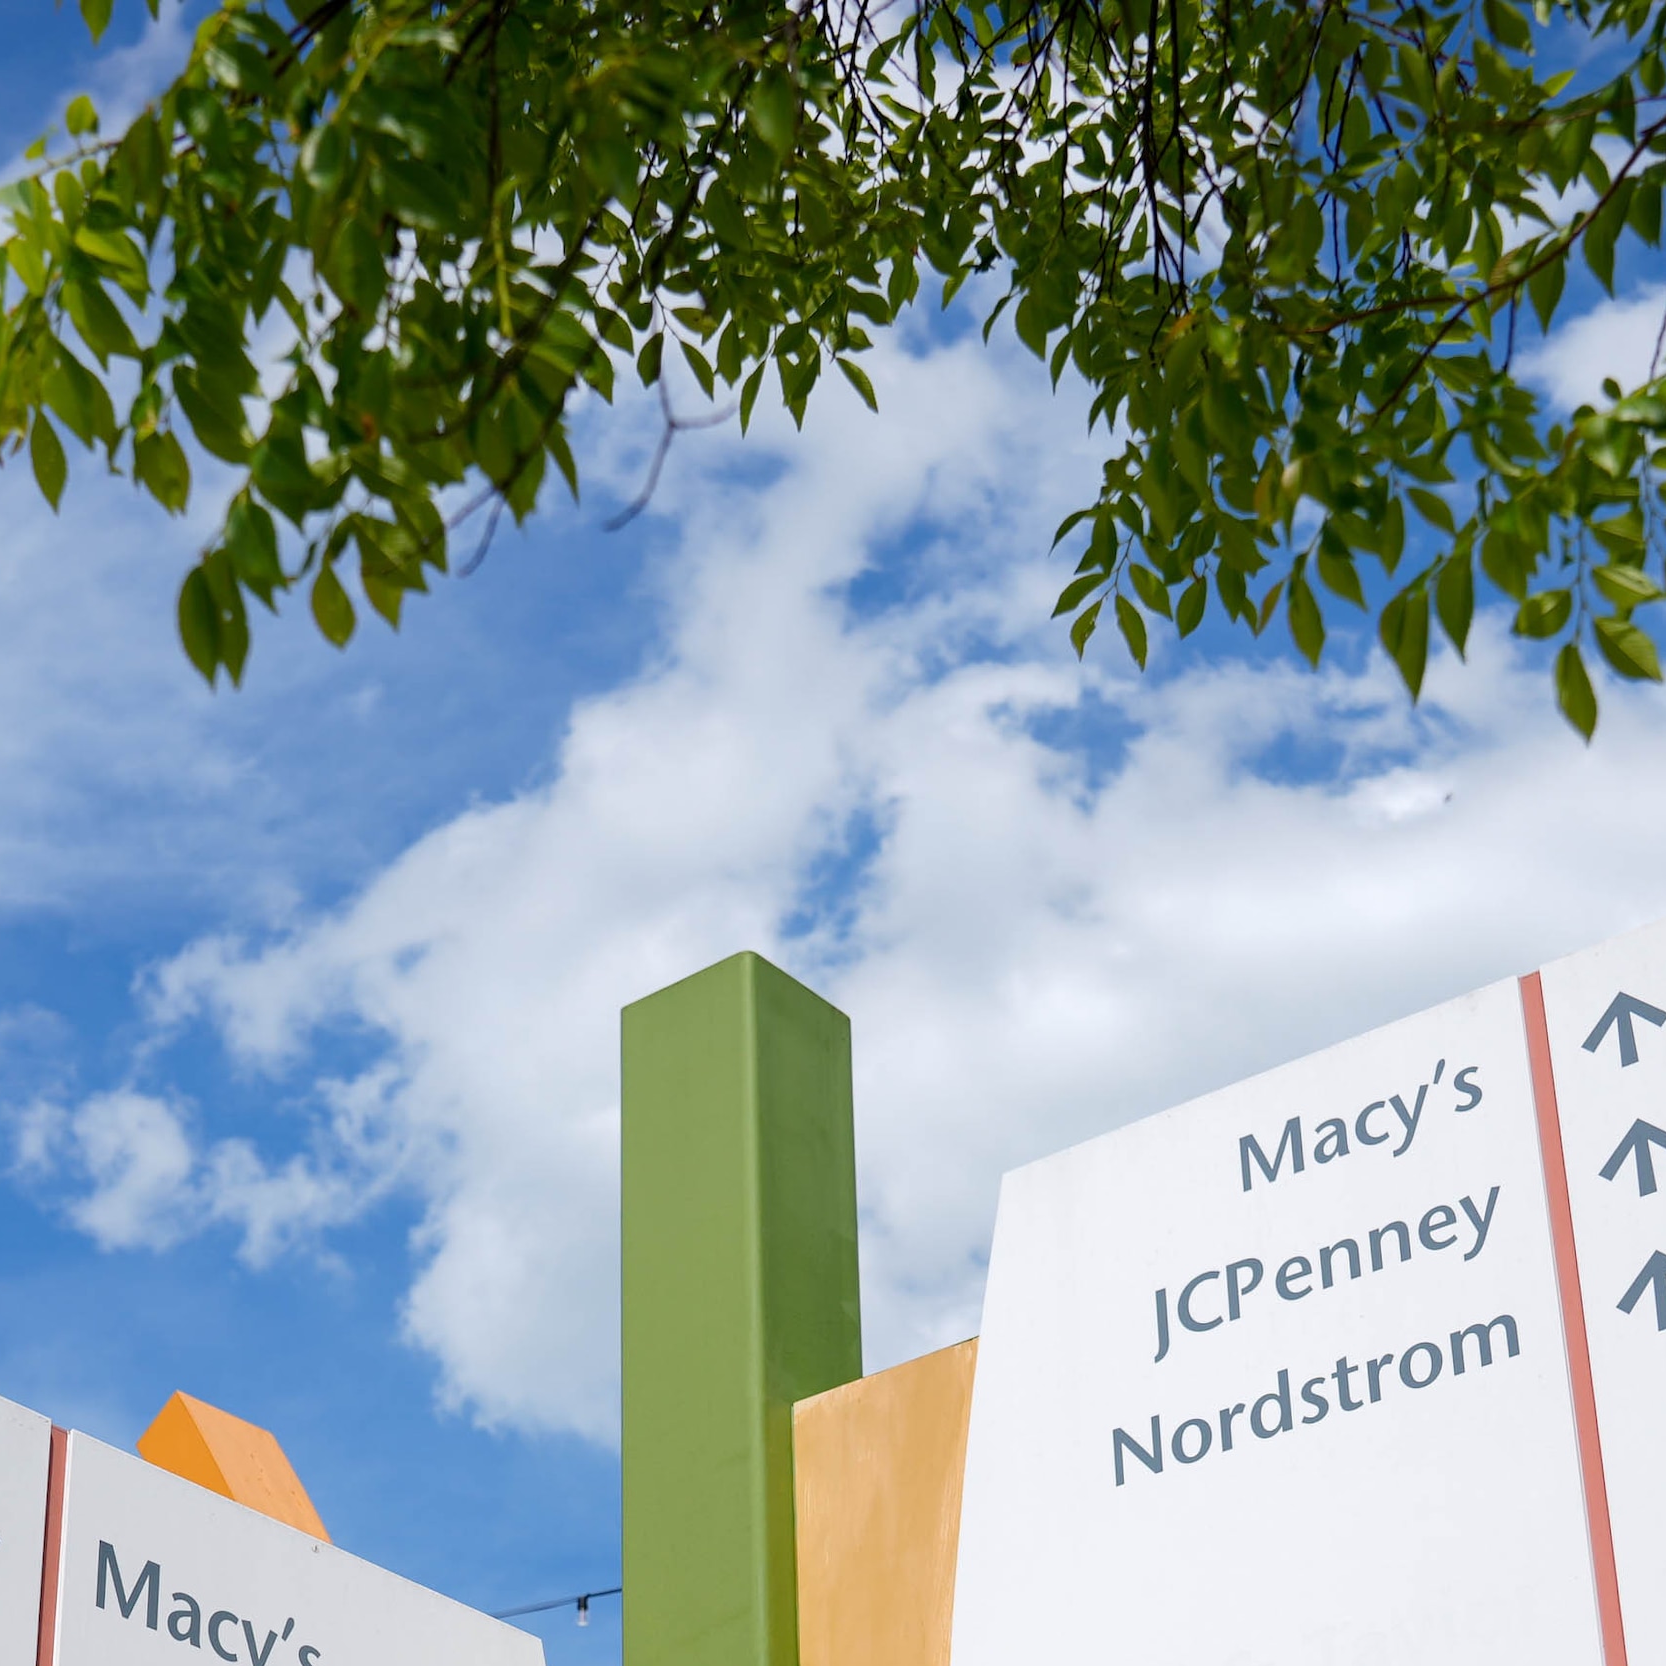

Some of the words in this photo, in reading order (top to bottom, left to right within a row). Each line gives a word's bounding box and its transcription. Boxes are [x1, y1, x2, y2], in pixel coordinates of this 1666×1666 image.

[1239, 1059, 1483, 1192] Macy's
[1154, 1185, 1501, 1363] JCPenney
[1112, 1314, 1521, 1487] Nordstrom
